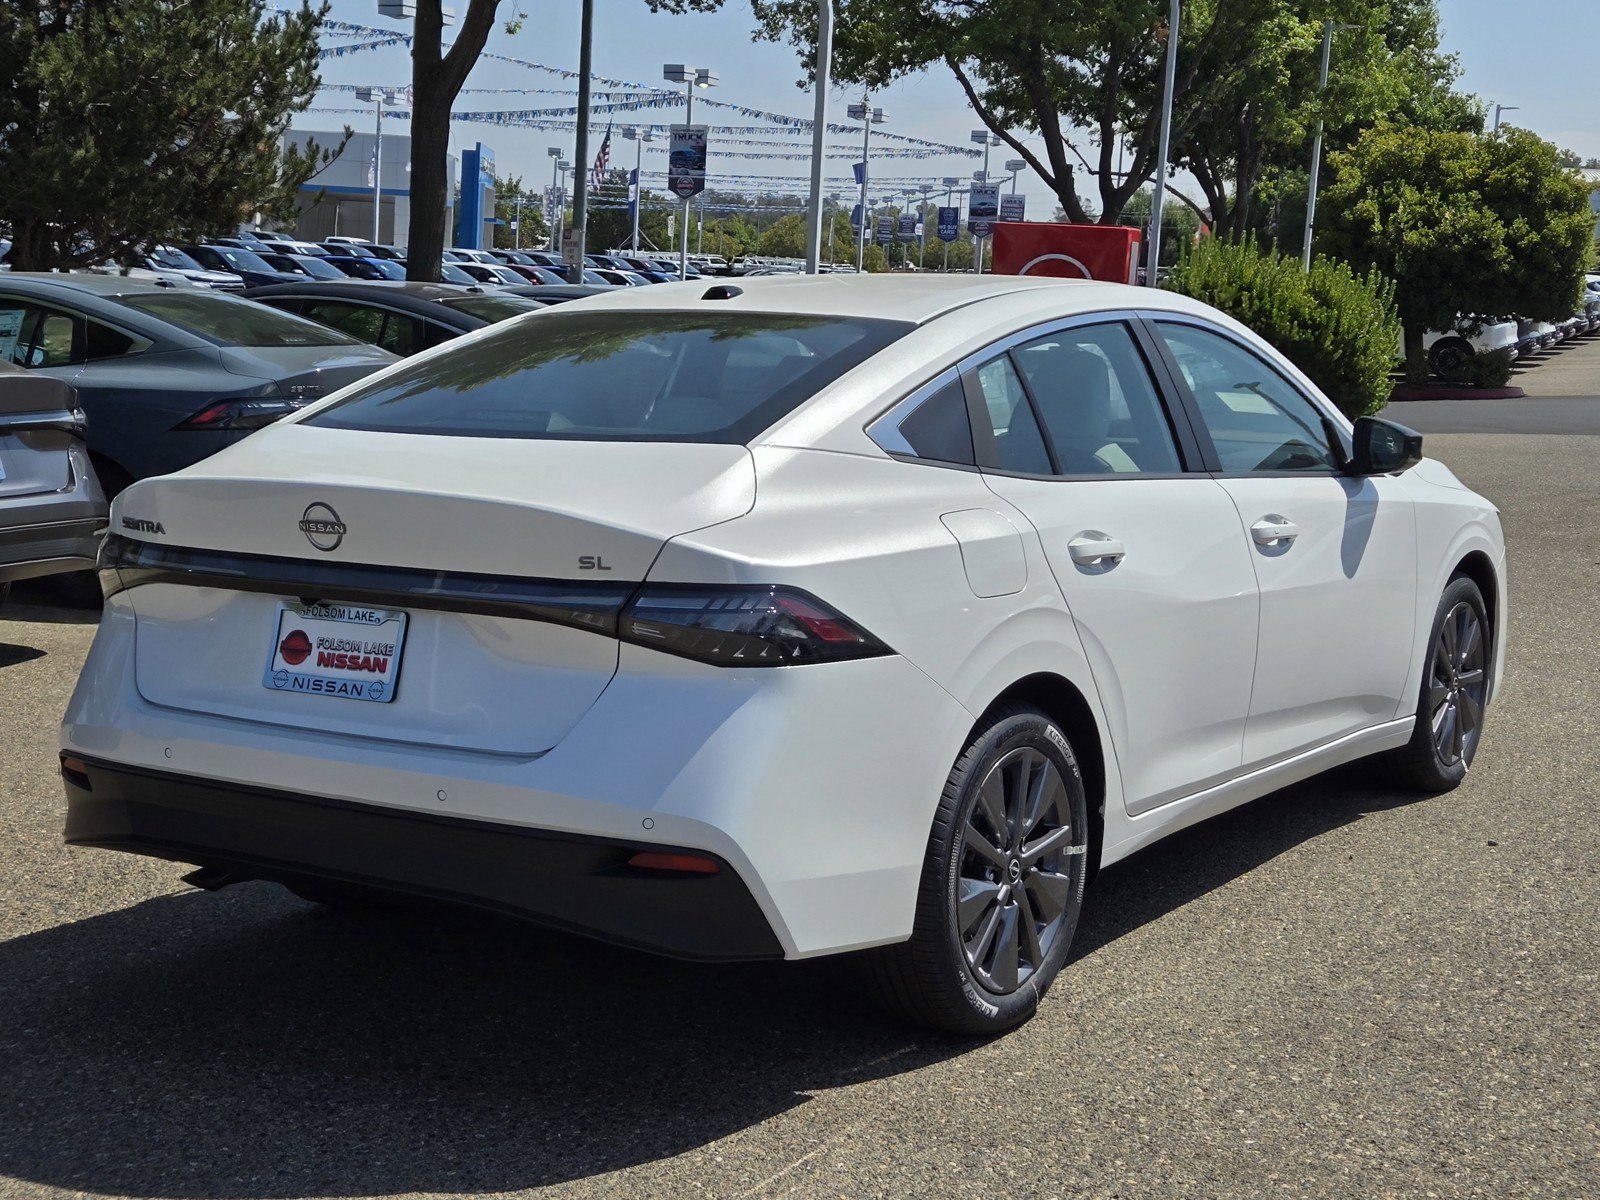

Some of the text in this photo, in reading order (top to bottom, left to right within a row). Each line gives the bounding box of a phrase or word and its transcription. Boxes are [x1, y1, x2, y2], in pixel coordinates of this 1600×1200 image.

[673, 133, 704, 142] TRUCK
[299, 521, 344, 534] NISSAN
[578, 555, 612, 571] SL
[306, 605, 375, 623] FOLSOM LAKE
[316, 636, 395, 657] FOLSOM LAKE
[316, 651, 388, 673] NISSAN
[292, 676, 364, 697] NISSAN
